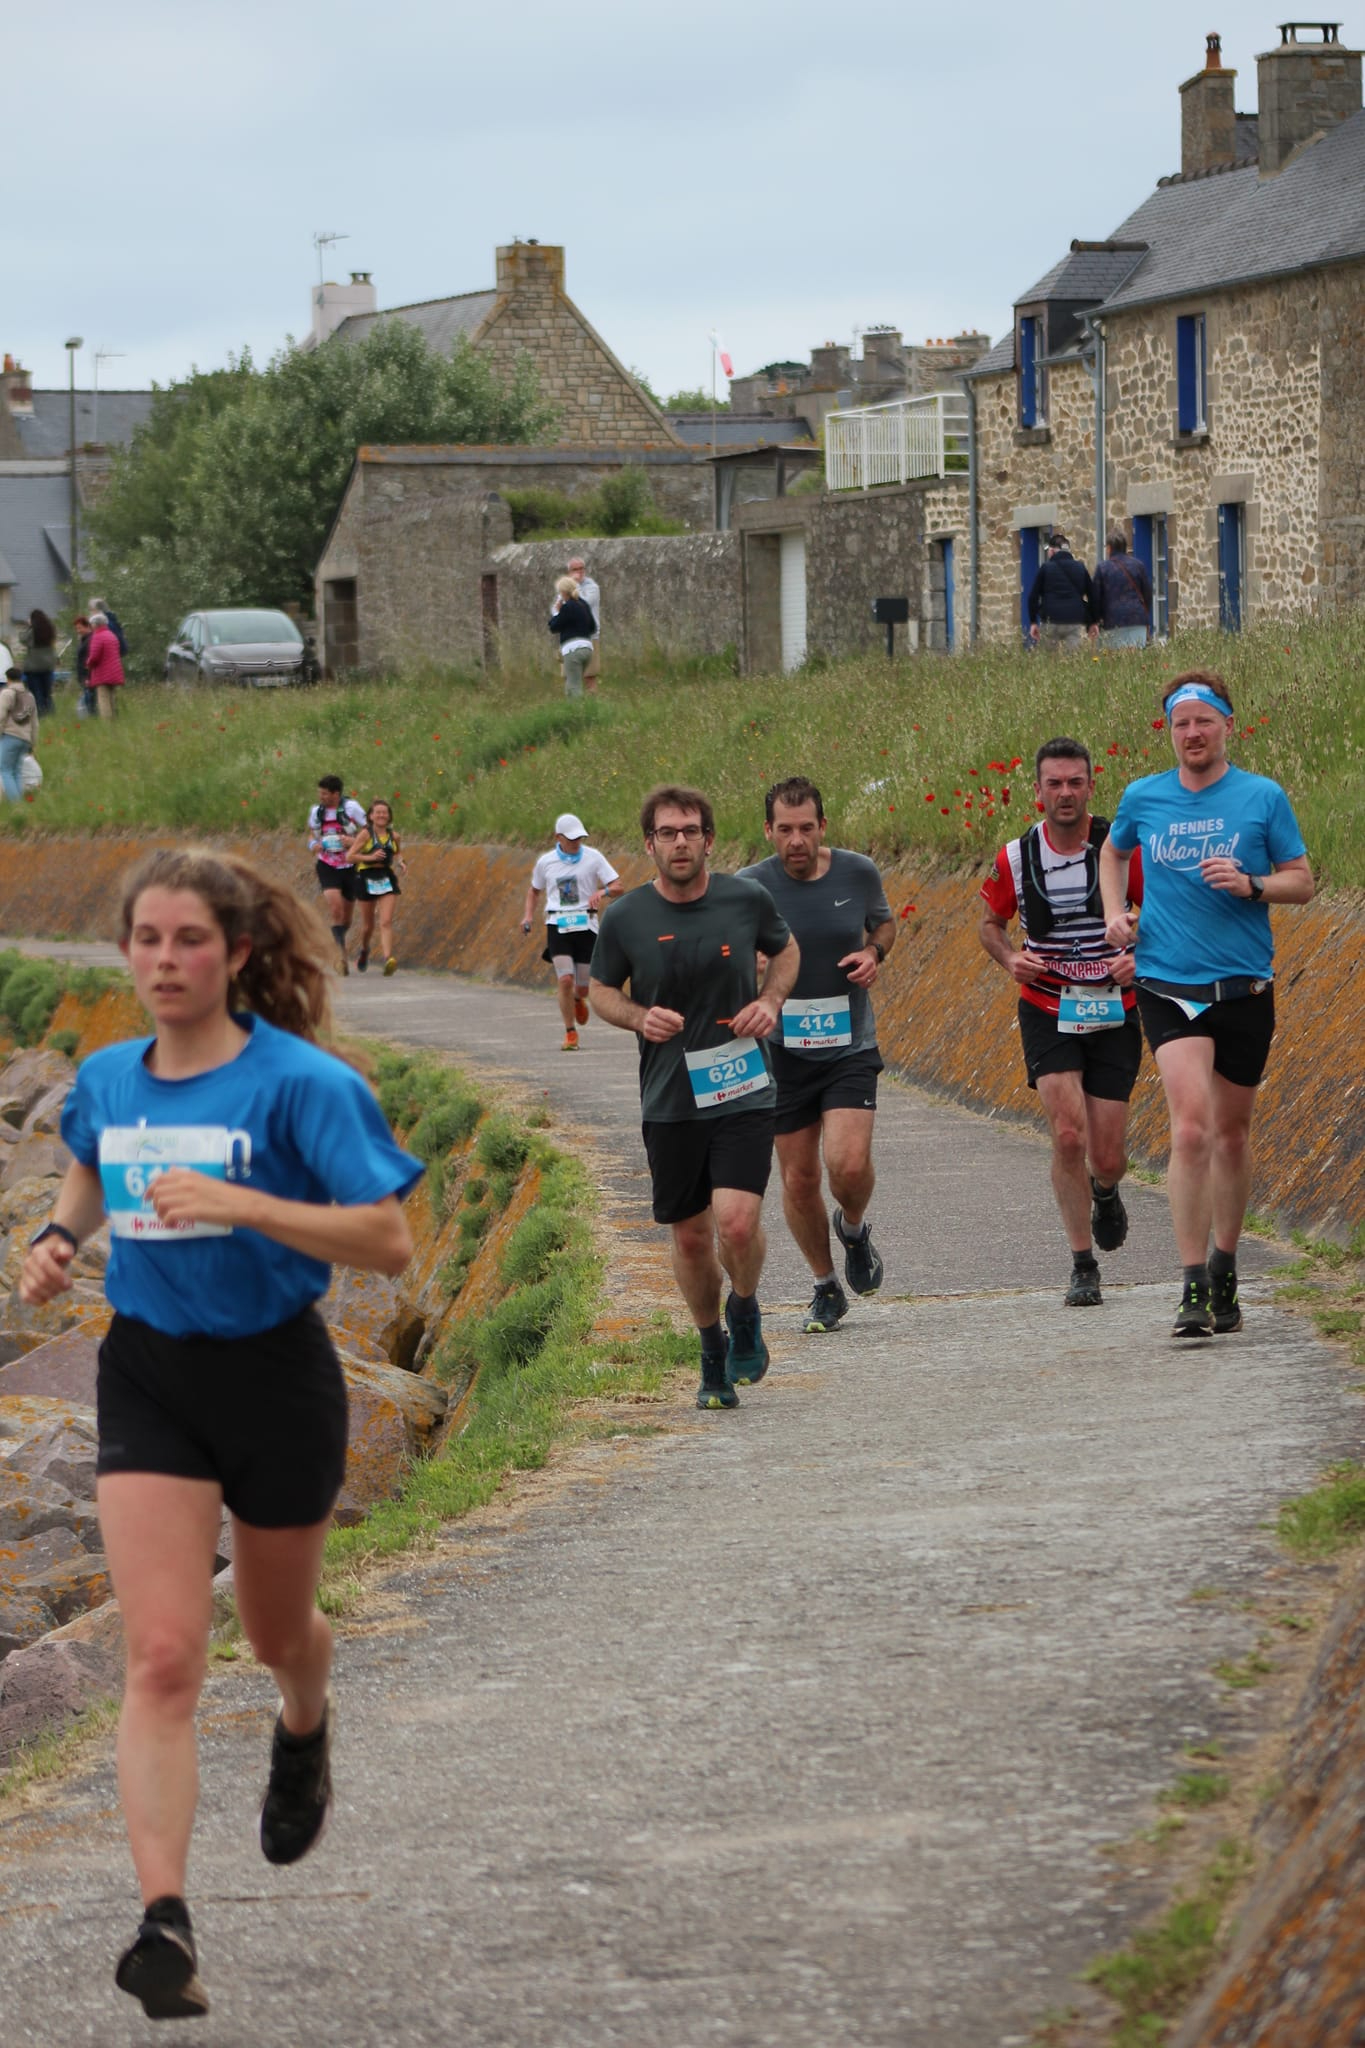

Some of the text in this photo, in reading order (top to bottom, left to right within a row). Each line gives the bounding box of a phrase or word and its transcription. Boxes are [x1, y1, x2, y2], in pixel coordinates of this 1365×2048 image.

[1168, 818, 1224, 836] RENNES
[1149, 832, 1241, 866] Urban Trail
[1075, 1001, 1109, 1016] 645
[799, 1013, 836, 1031] 414
[708, 1057, 748, 1083] 620
[727, 1081, 754, 1098] market
